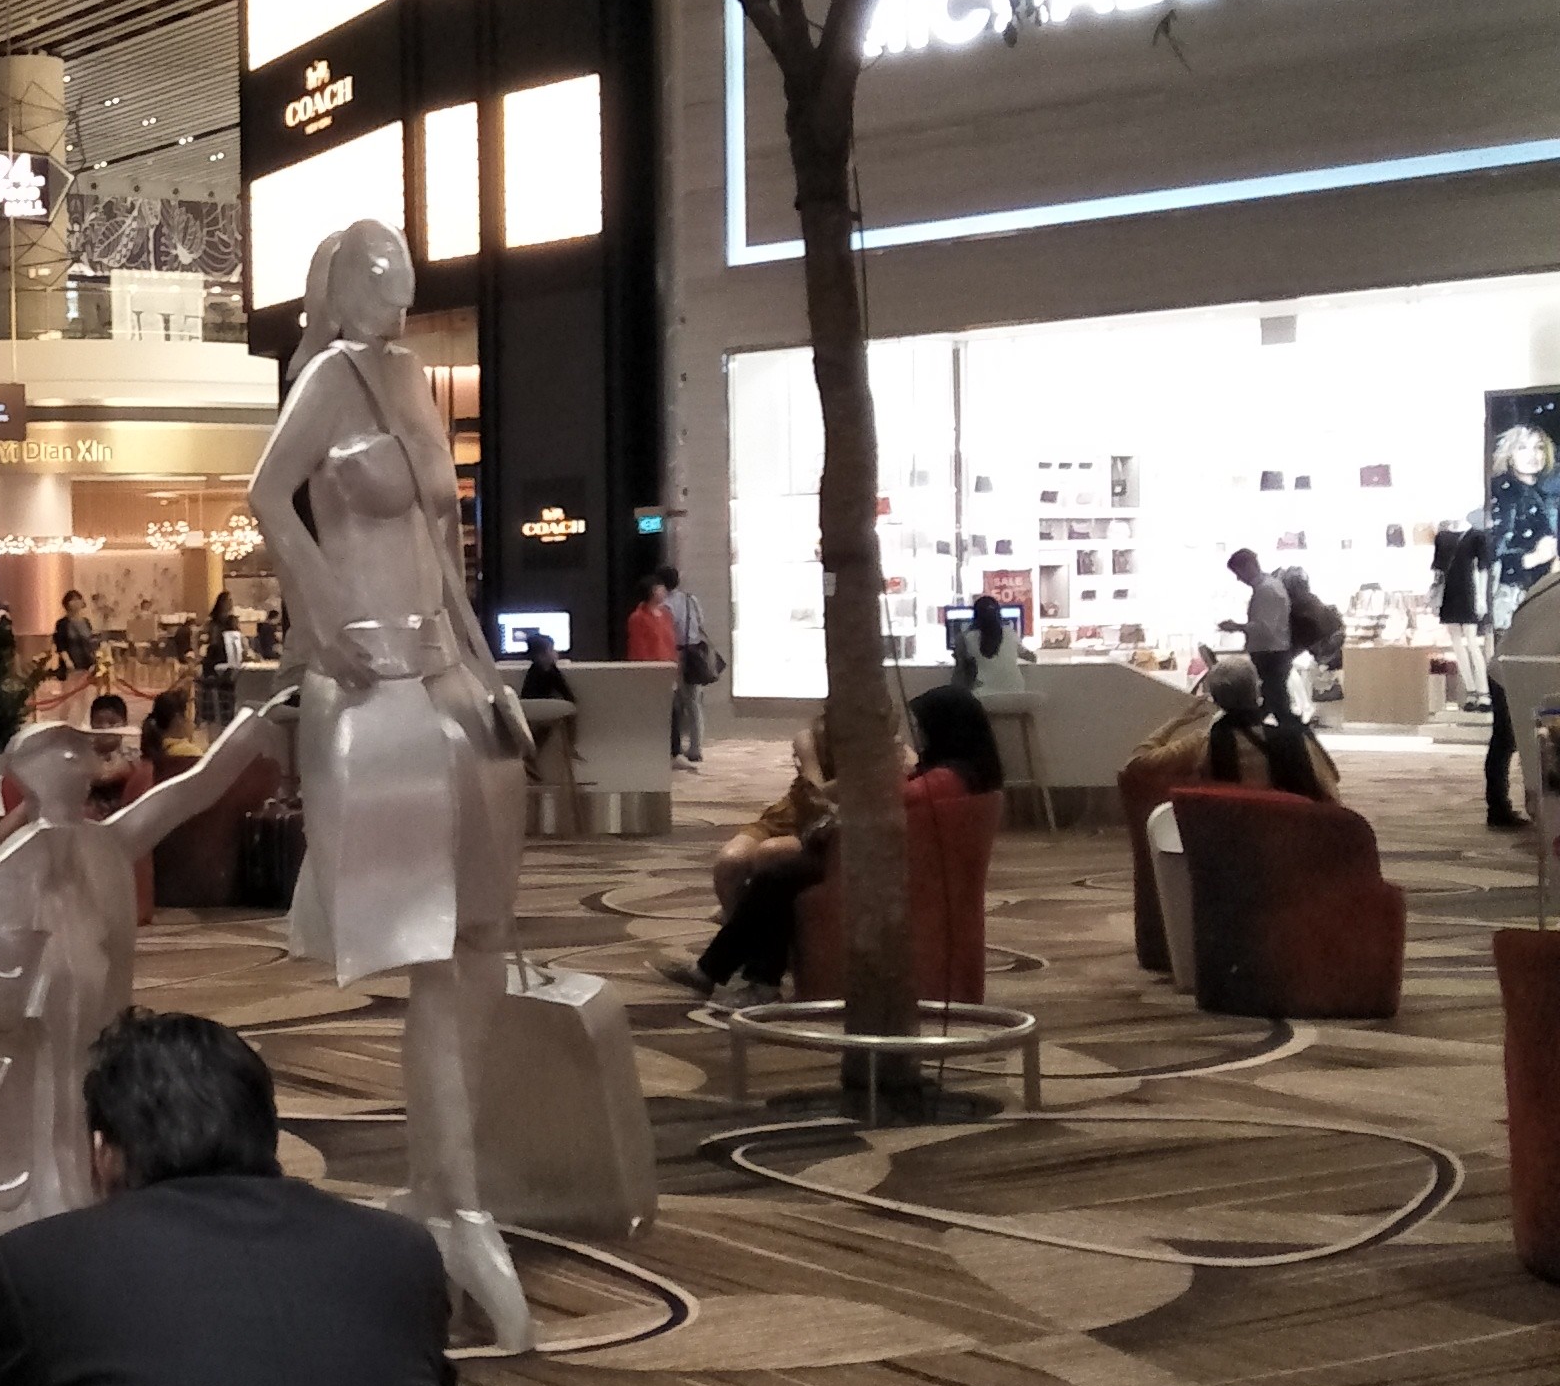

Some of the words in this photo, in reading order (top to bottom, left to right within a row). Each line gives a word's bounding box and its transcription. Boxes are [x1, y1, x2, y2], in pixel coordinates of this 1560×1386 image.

[285, 76, 354, 127] COACH
[24, 441, 72, 461] Dian
[522, 519, 586, 537] COACH
